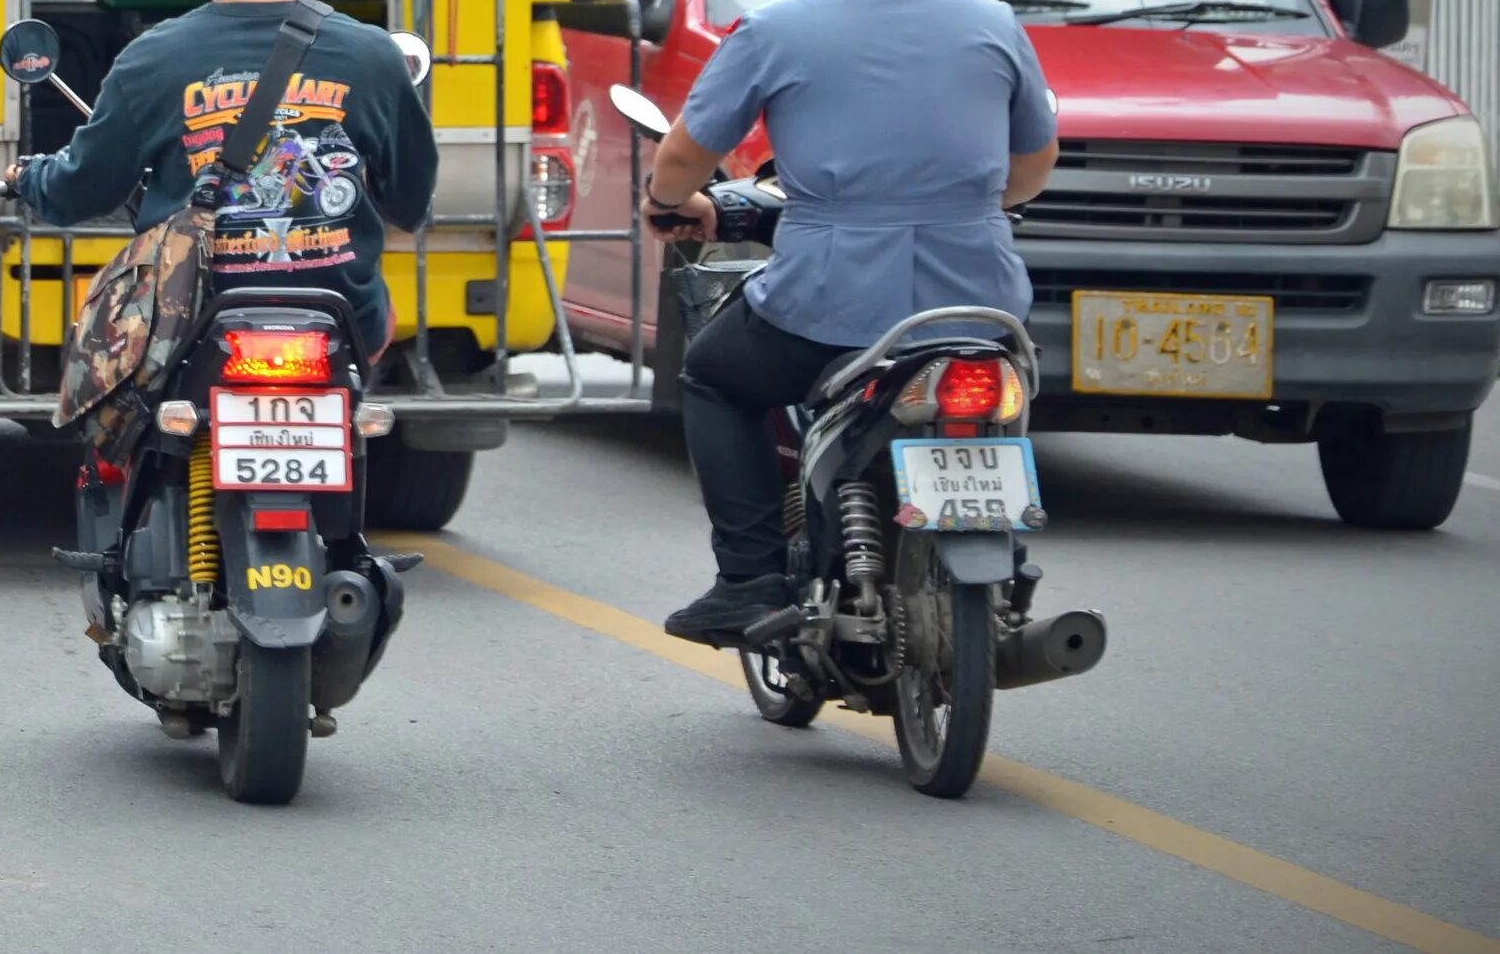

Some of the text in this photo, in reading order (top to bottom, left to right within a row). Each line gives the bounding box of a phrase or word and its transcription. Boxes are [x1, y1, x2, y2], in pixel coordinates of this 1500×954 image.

[1128, 175, 1212, 191] ISUZU
[248, 397, 316, 422] 1กจ
[250, 429, 315, 447] เชียงใหม่
[236, 458, 329, 484] 5284
[934, 476, 1003, 493] เชียงใหม่
[246, 563, 312, 590] N90
